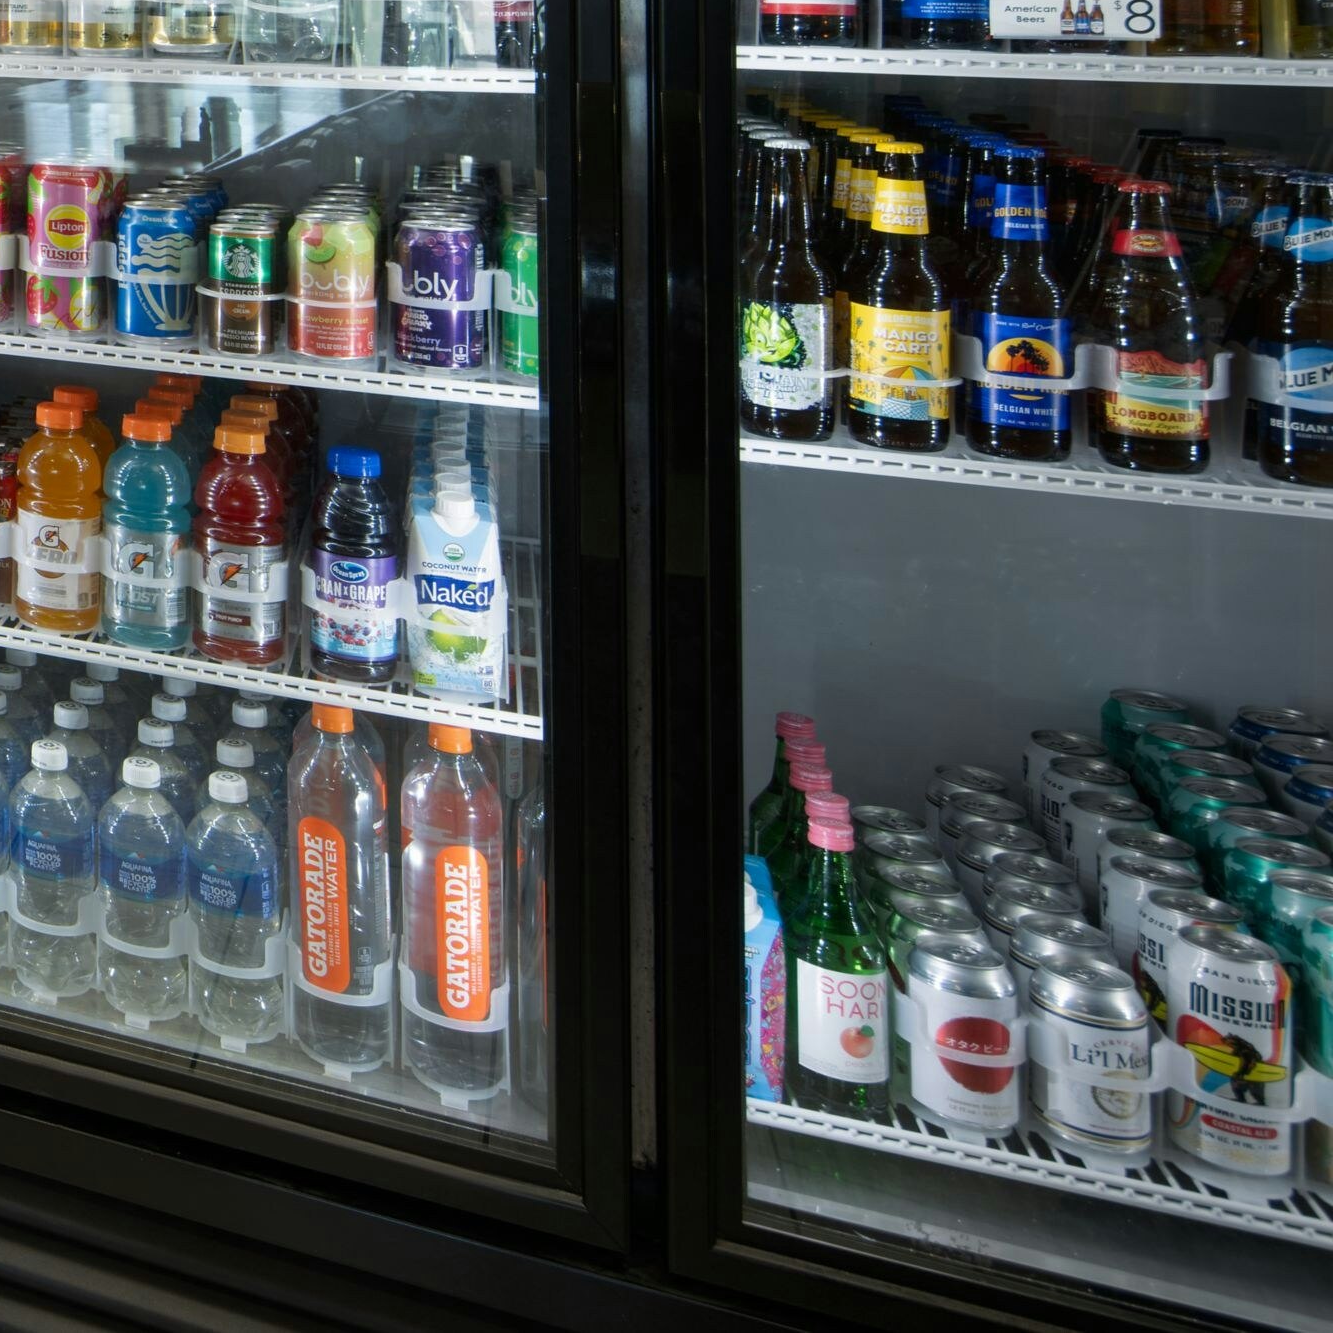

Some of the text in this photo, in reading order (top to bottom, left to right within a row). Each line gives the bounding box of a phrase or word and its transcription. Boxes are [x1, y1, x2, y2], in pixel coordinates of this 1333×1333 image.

[1005, 4, 1057, 14] American
[1114, 0, 1122, 11] $
[1017, 14, 1046, 24] Beers
[51, 220, 86, 233] Lipton
[874, 328, 938, 344] MANGO
[885, 340, 931, 355] CART
[994, 401, 1031, 415] BELGIAN
[1111, 406, 1195, 423] LONGBOARD
[422, 561, 487, 574] COCONUT WATER
[349, 584, 386, 602] GRAPE
[421, 578, 489, 607] Naked
[36, 850, 62, 862] 100%
[327, 838, 338, 899] WATER
[130, 872, 157, 885] 100%
[210, 885, 237, 898] 100%
[470, 866, 482, 927] WATER
[303, 835, 329, 979] GATORADE
[445, 862, 470, 1010] GATORADE
[1202, 966, 1227, 977] SAN
